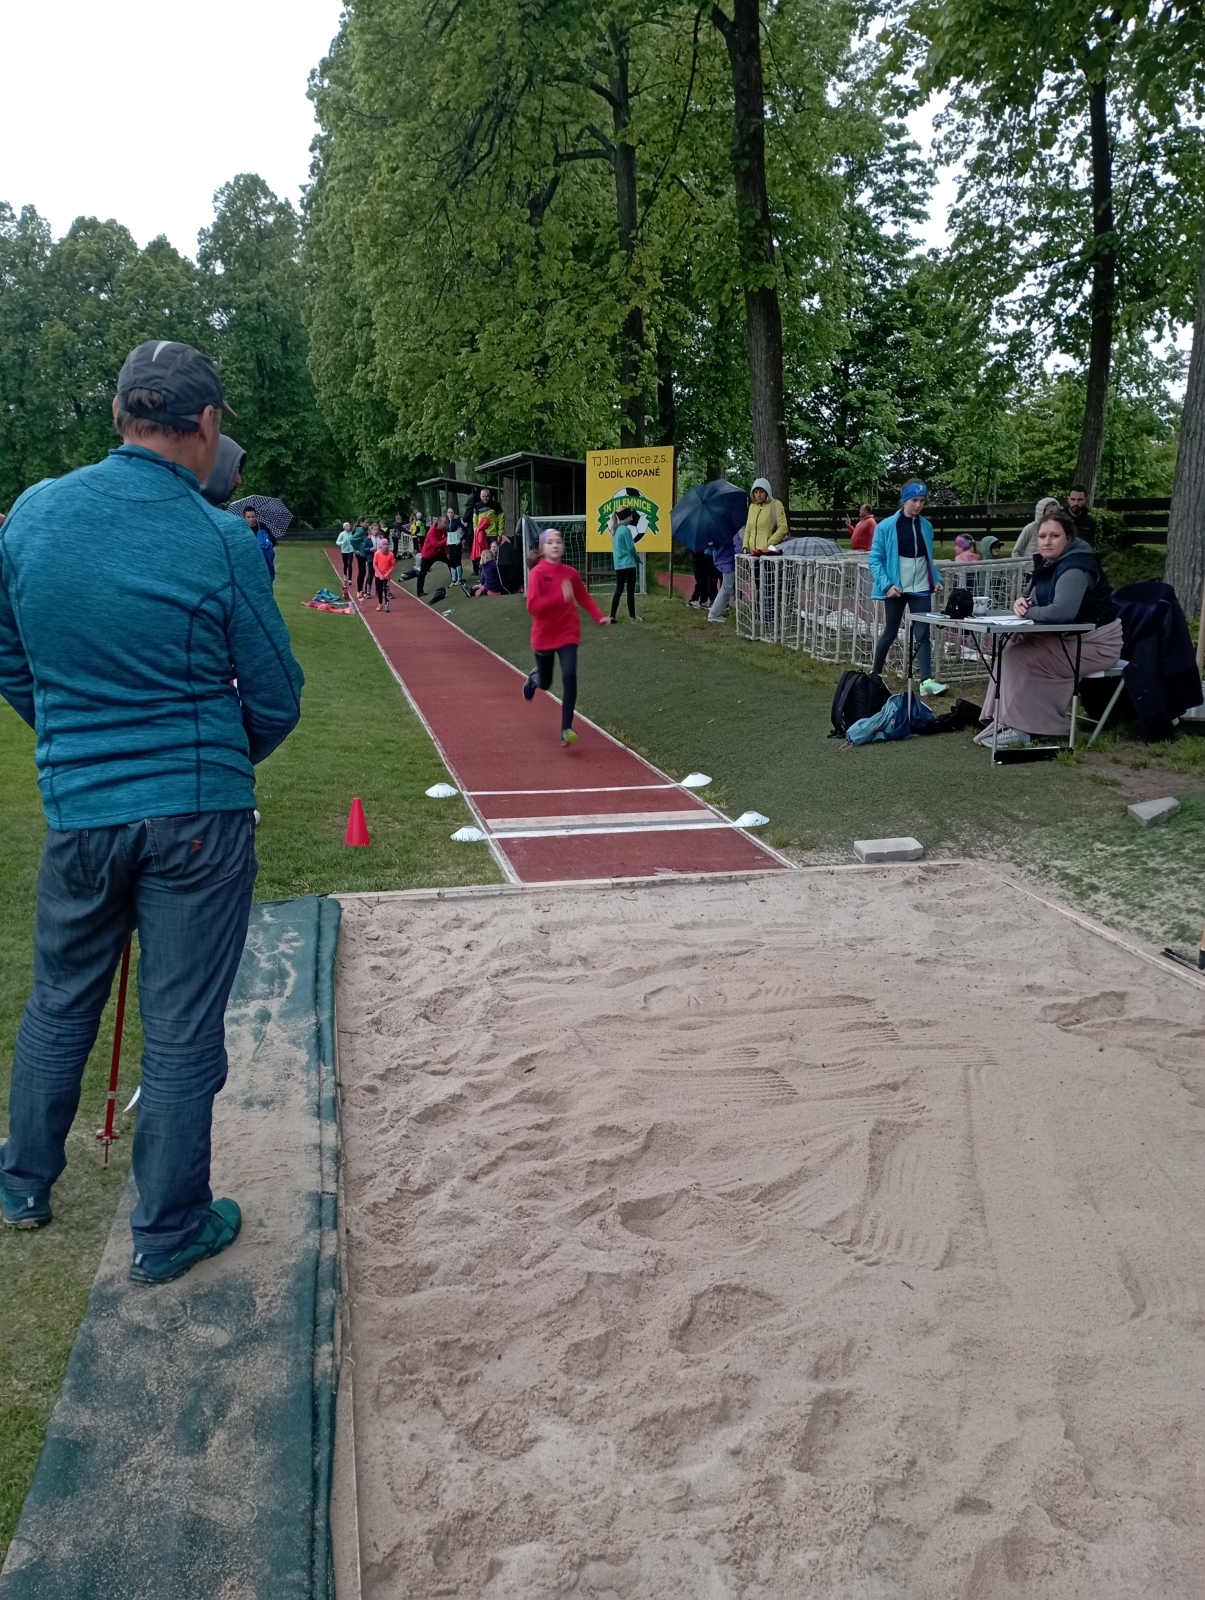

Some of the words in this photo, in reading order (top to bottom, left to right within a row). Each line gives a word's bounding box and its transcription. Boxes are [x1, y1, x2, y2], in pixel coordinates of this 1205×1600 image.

[592, 456, 602, 467] TJ
[604, 453, 651, 466] Jilemnice
[598, 468, 624, 479] ODDÍL
[626, 466, 660, 478] KOPANÉ
[602, 501, 612, 514] SK
[613, 498, 651, 512] JILEMNICE
